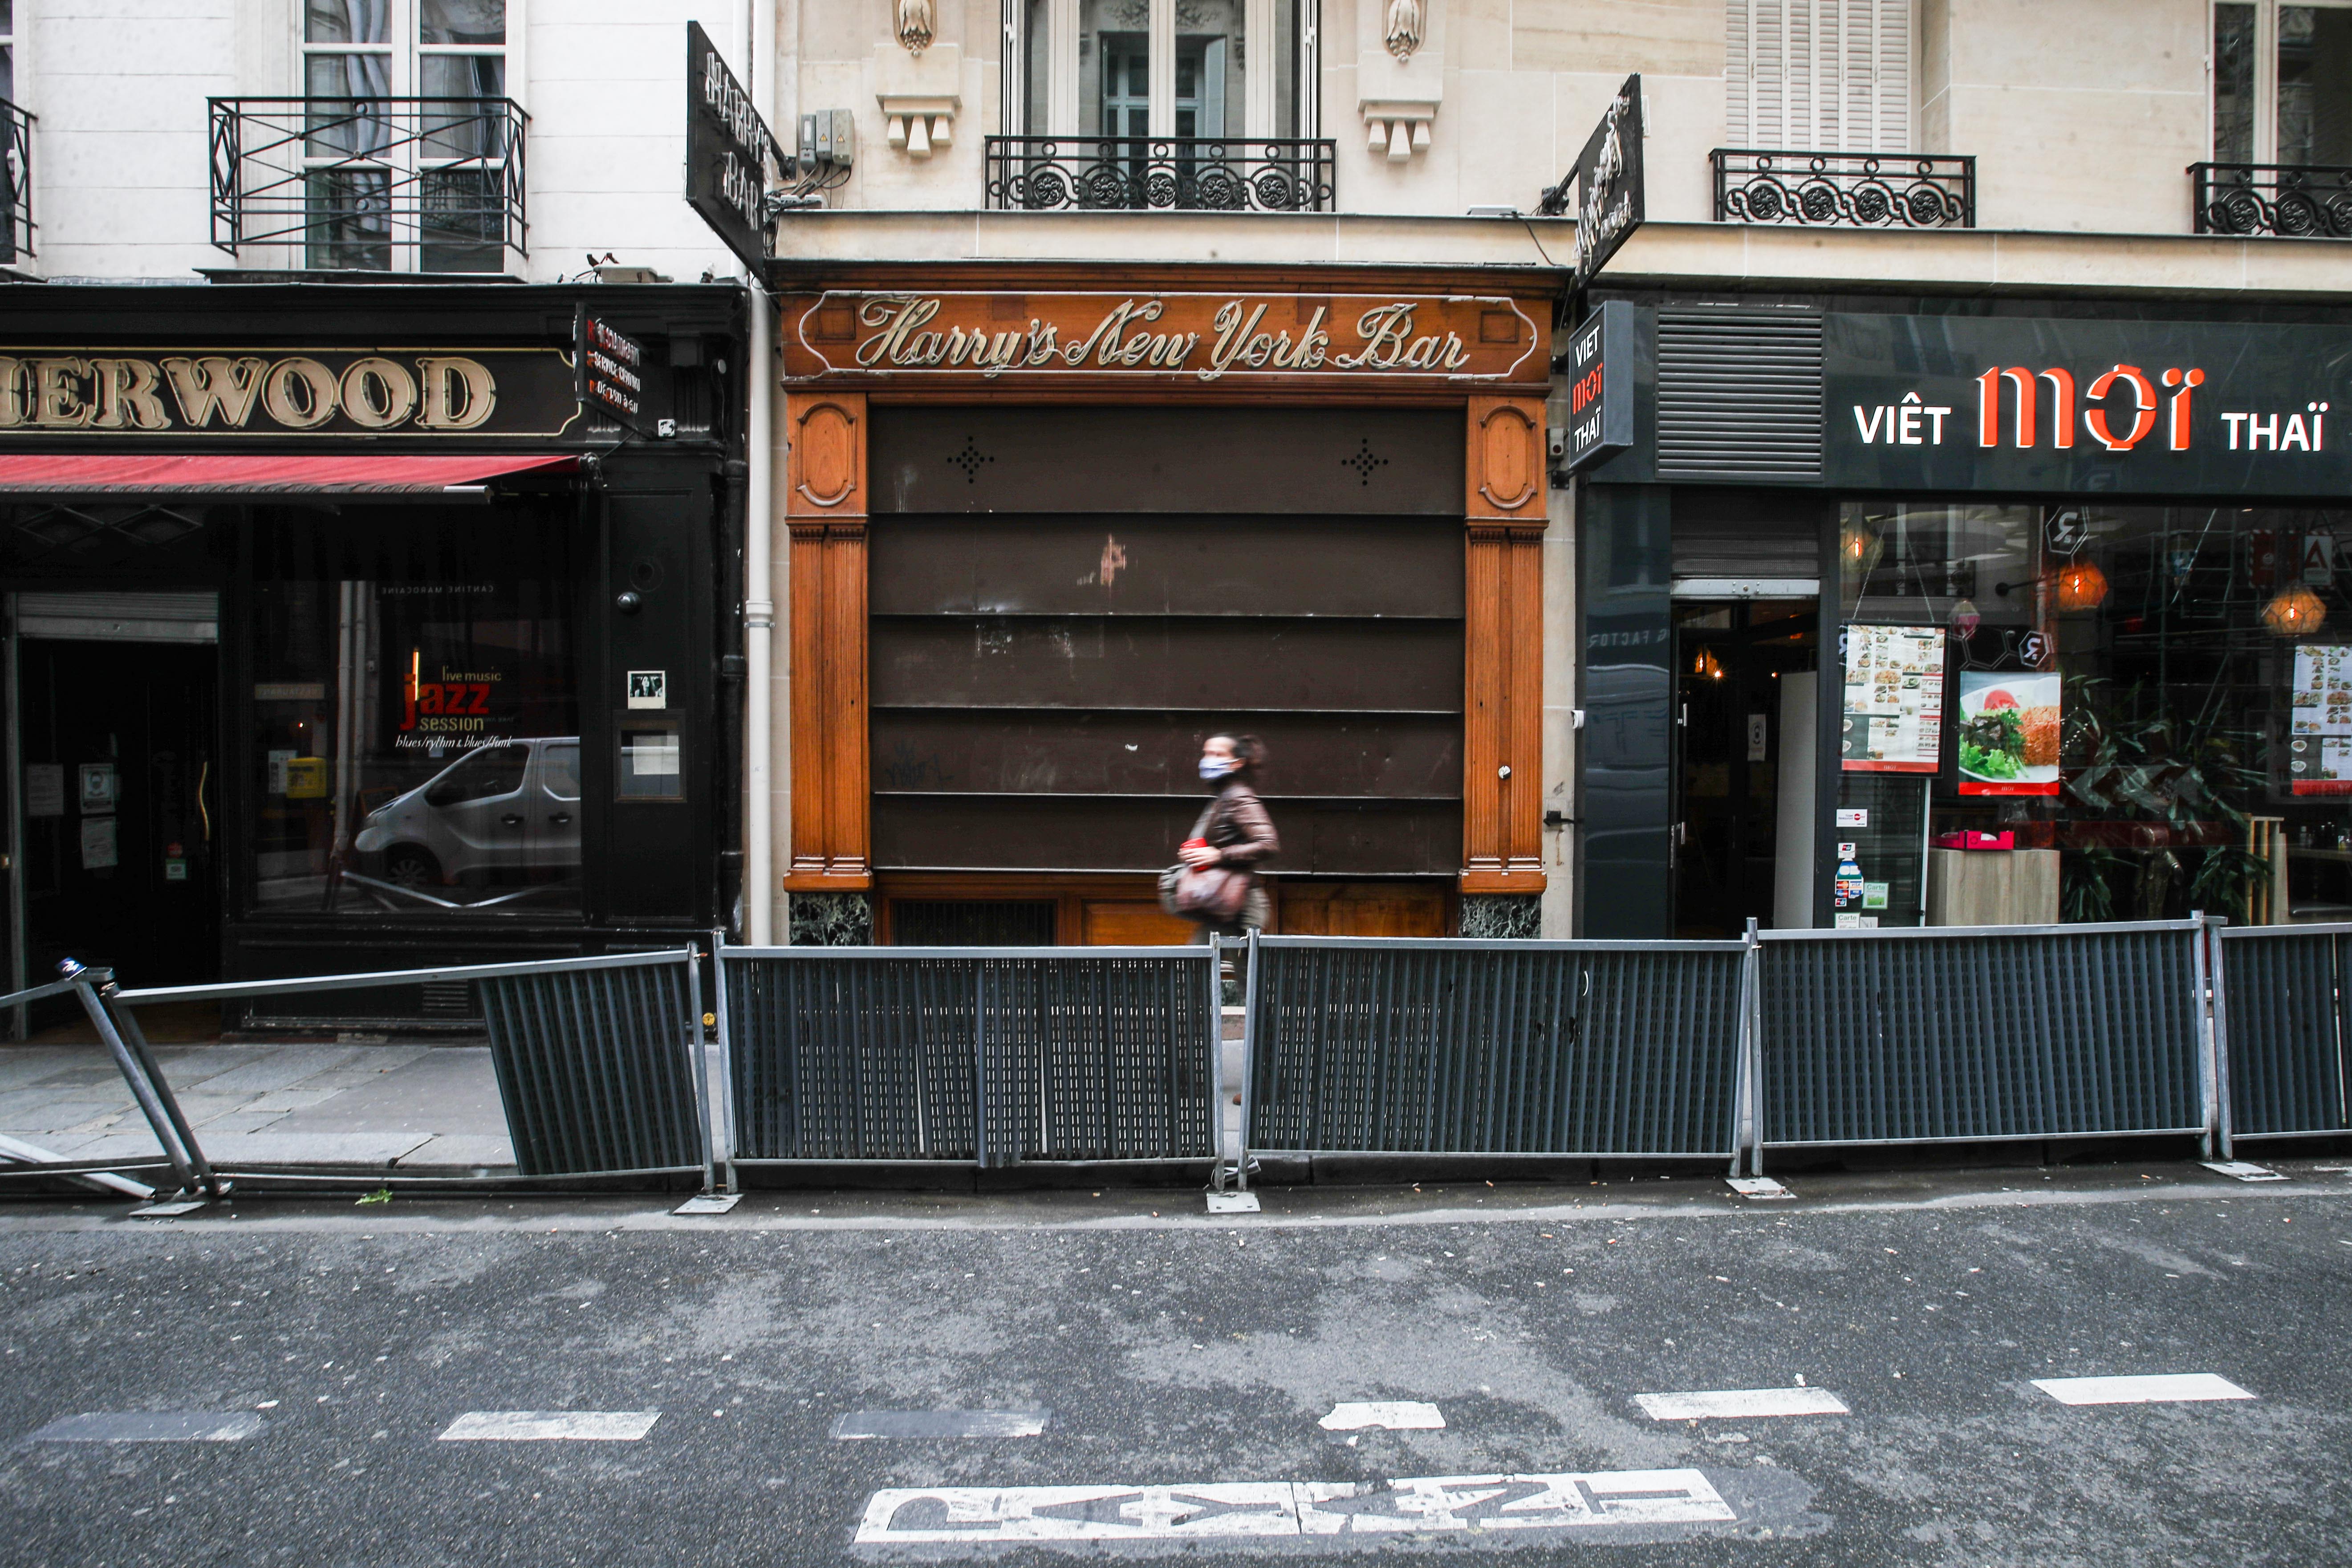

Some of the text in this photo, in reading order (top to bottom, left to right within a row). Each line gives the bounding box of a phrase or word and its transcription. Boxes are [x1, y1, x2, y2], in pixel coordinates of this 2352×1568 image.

[722, 150, 758, 231] BAR
[856, 295, 1470, 381] Harry's New York Bar
[1575, 325, 1600, 367] VIET
[1574, 405, 1602, 453] THAÏ
[1853, 392, 1951, 445] VIÊT
[2221, 402, 2328, 451] THAÏ
[442, 666, 502, 682] live music
[399, 672, 490, 731] jazz
[419, 717, 484, 731] session
